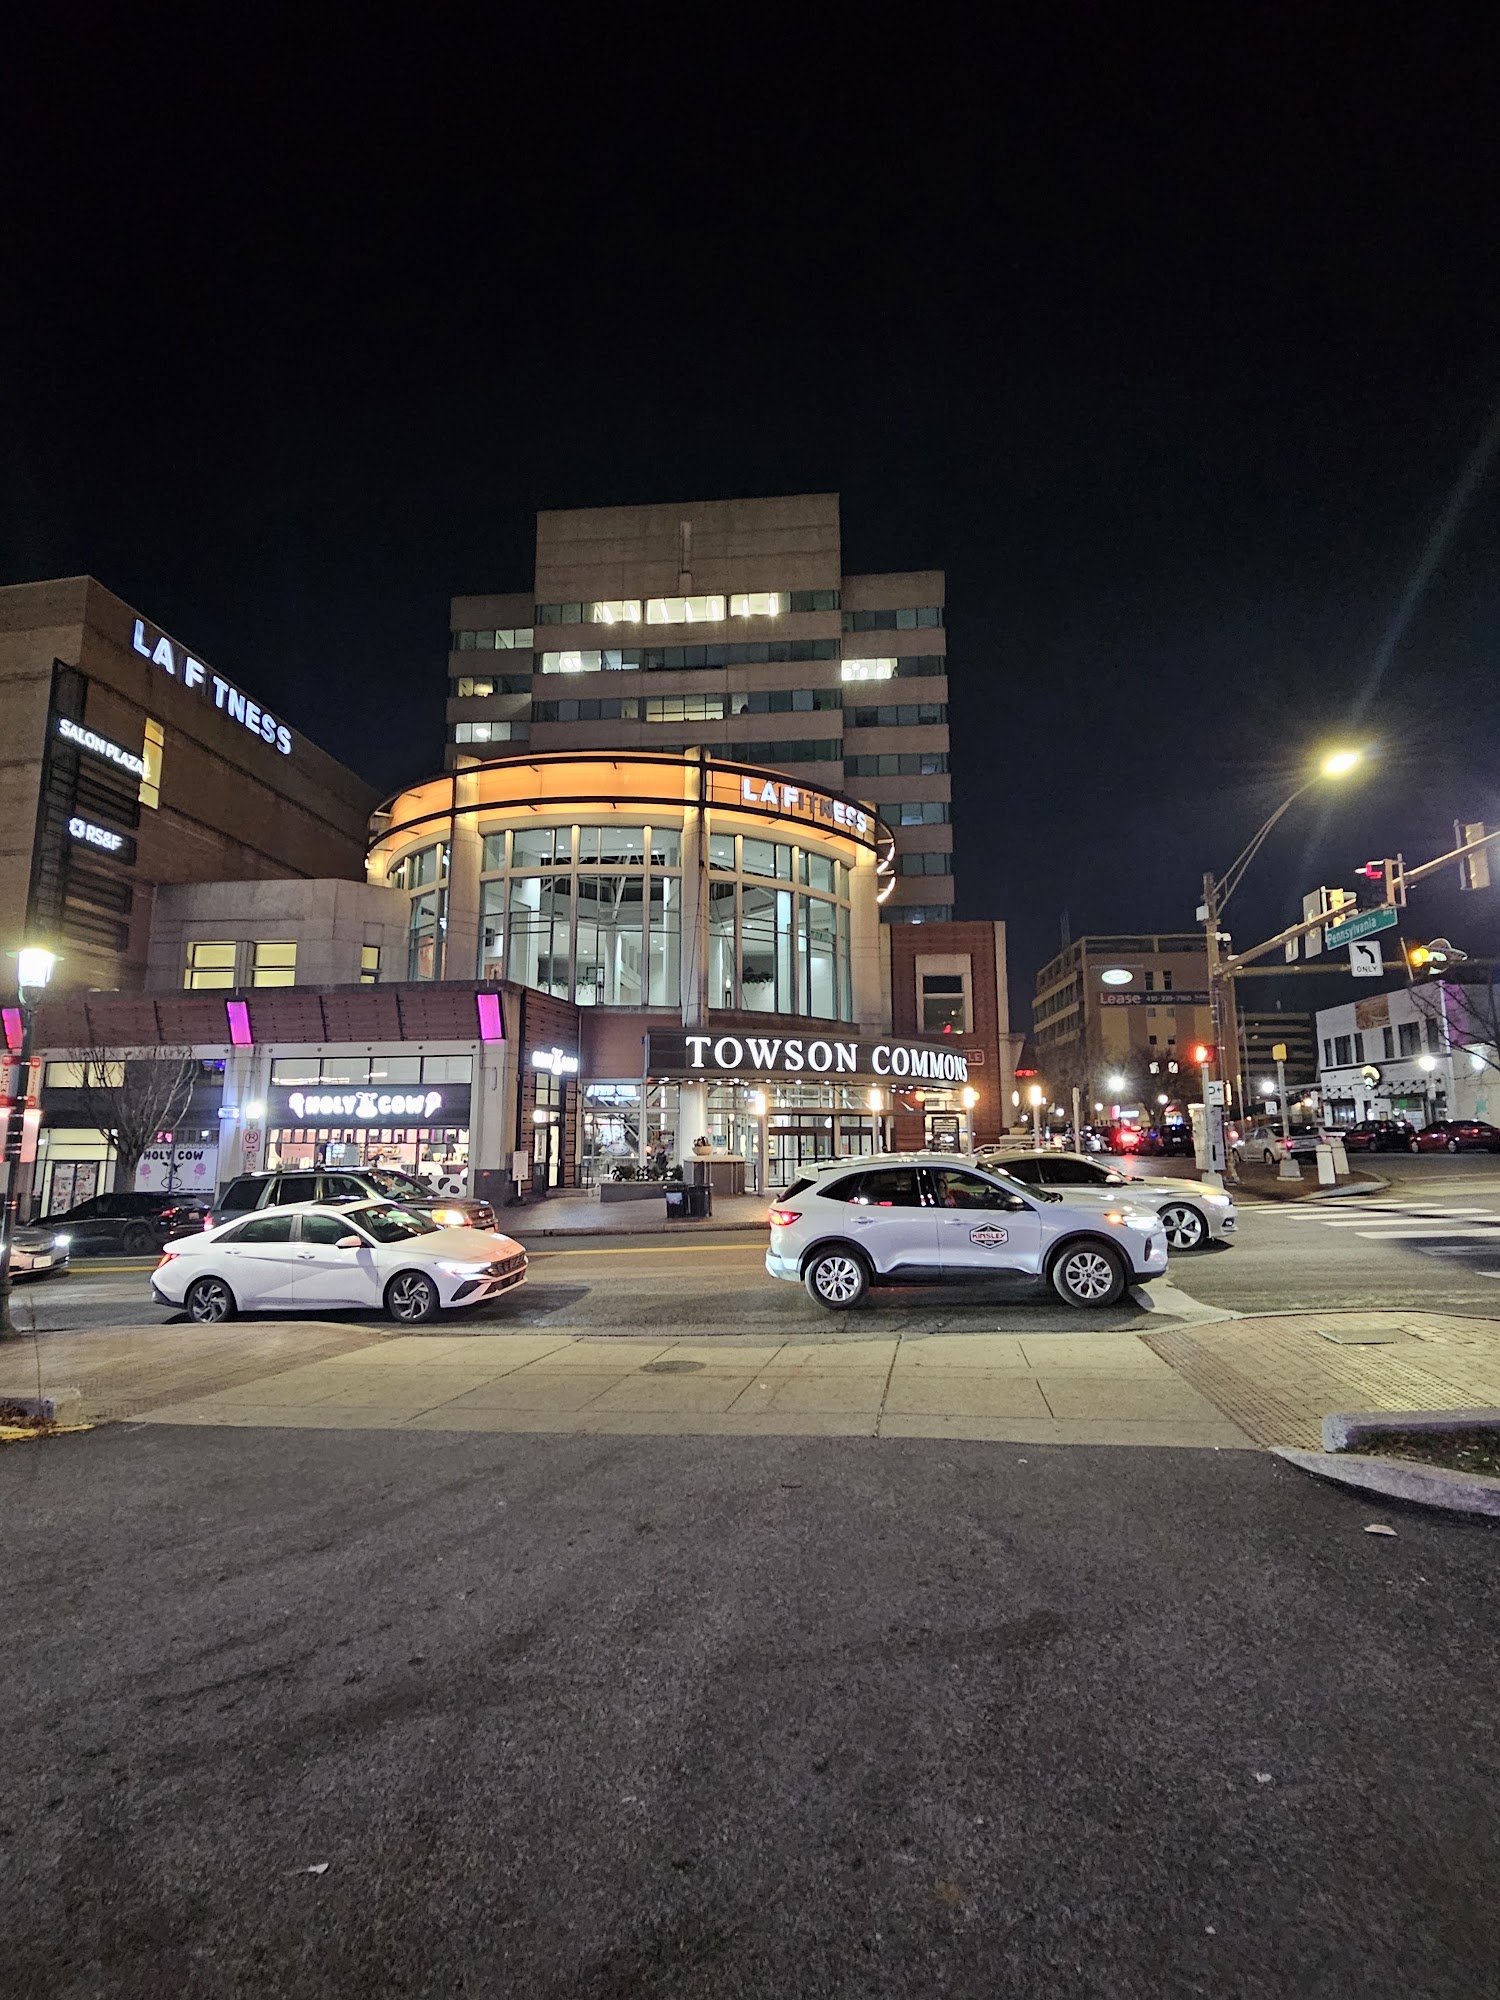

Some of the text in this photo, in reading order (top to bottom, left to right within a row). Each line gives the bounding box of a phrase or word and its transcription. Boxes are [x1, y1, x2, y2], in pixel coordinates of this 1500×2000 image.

[133, 619, 175, 675] LA
[59, 718, 145, 776] SALON PLAZA
[742, 778, 867, 833] LA FITNESS
[86, 824, 123, 851] RS&F
[1327, 917, 1377, 946] Pennsylvania
[1356, 965, 1378, 973] ONLY
[1100, 992, 1141, 1005] Lease
[685, 1036, 968, 1082] TOWSON COMMONS
[305, 1094, 425, 1115] HOLY COW
[143, 1150, 204, 1160] HOLY COW
